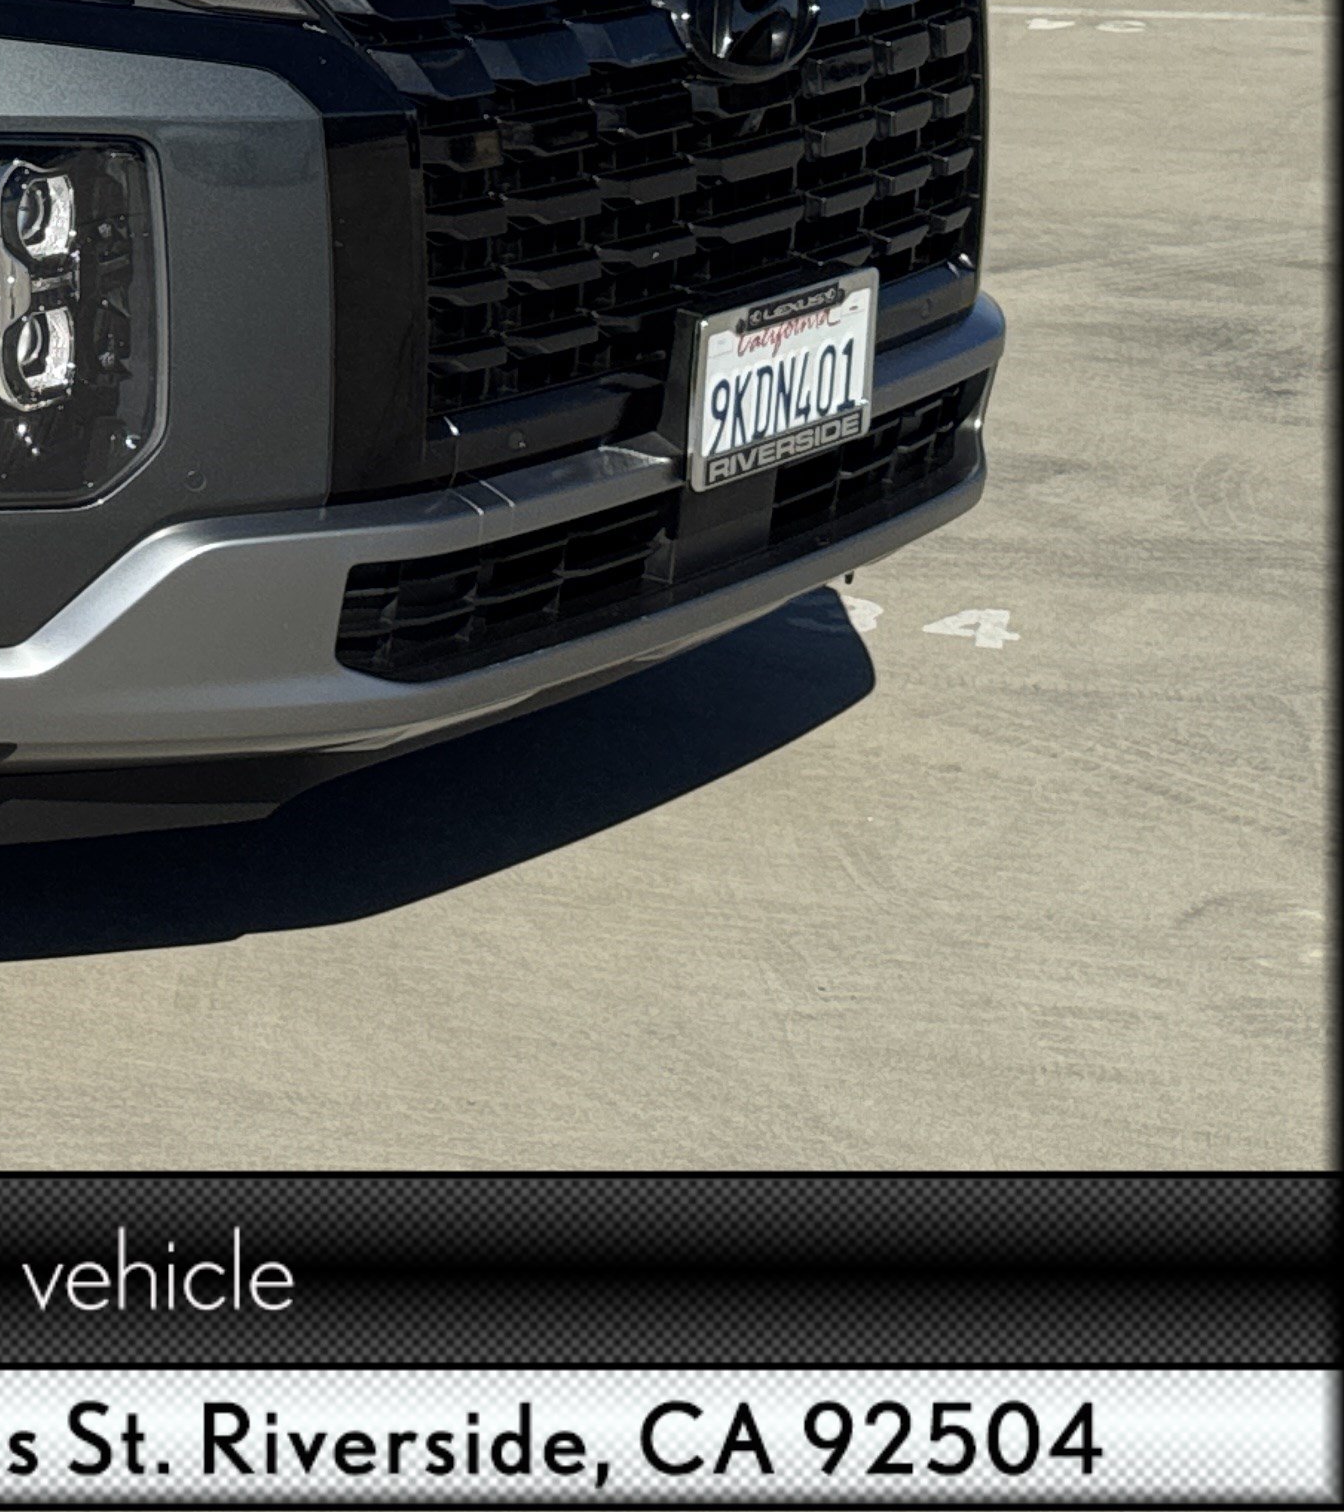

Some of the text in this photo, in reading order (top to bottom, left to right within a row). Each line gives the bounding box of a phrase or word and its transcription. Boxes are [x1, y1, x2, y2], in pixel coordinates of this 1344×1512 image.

[736, 308, 841, 357] California
[762, 292, 825, 320] LEXUS
[708, 337, 857, 455] 9KDN401
[708, 412, 861, 484] RIVERSIDE
